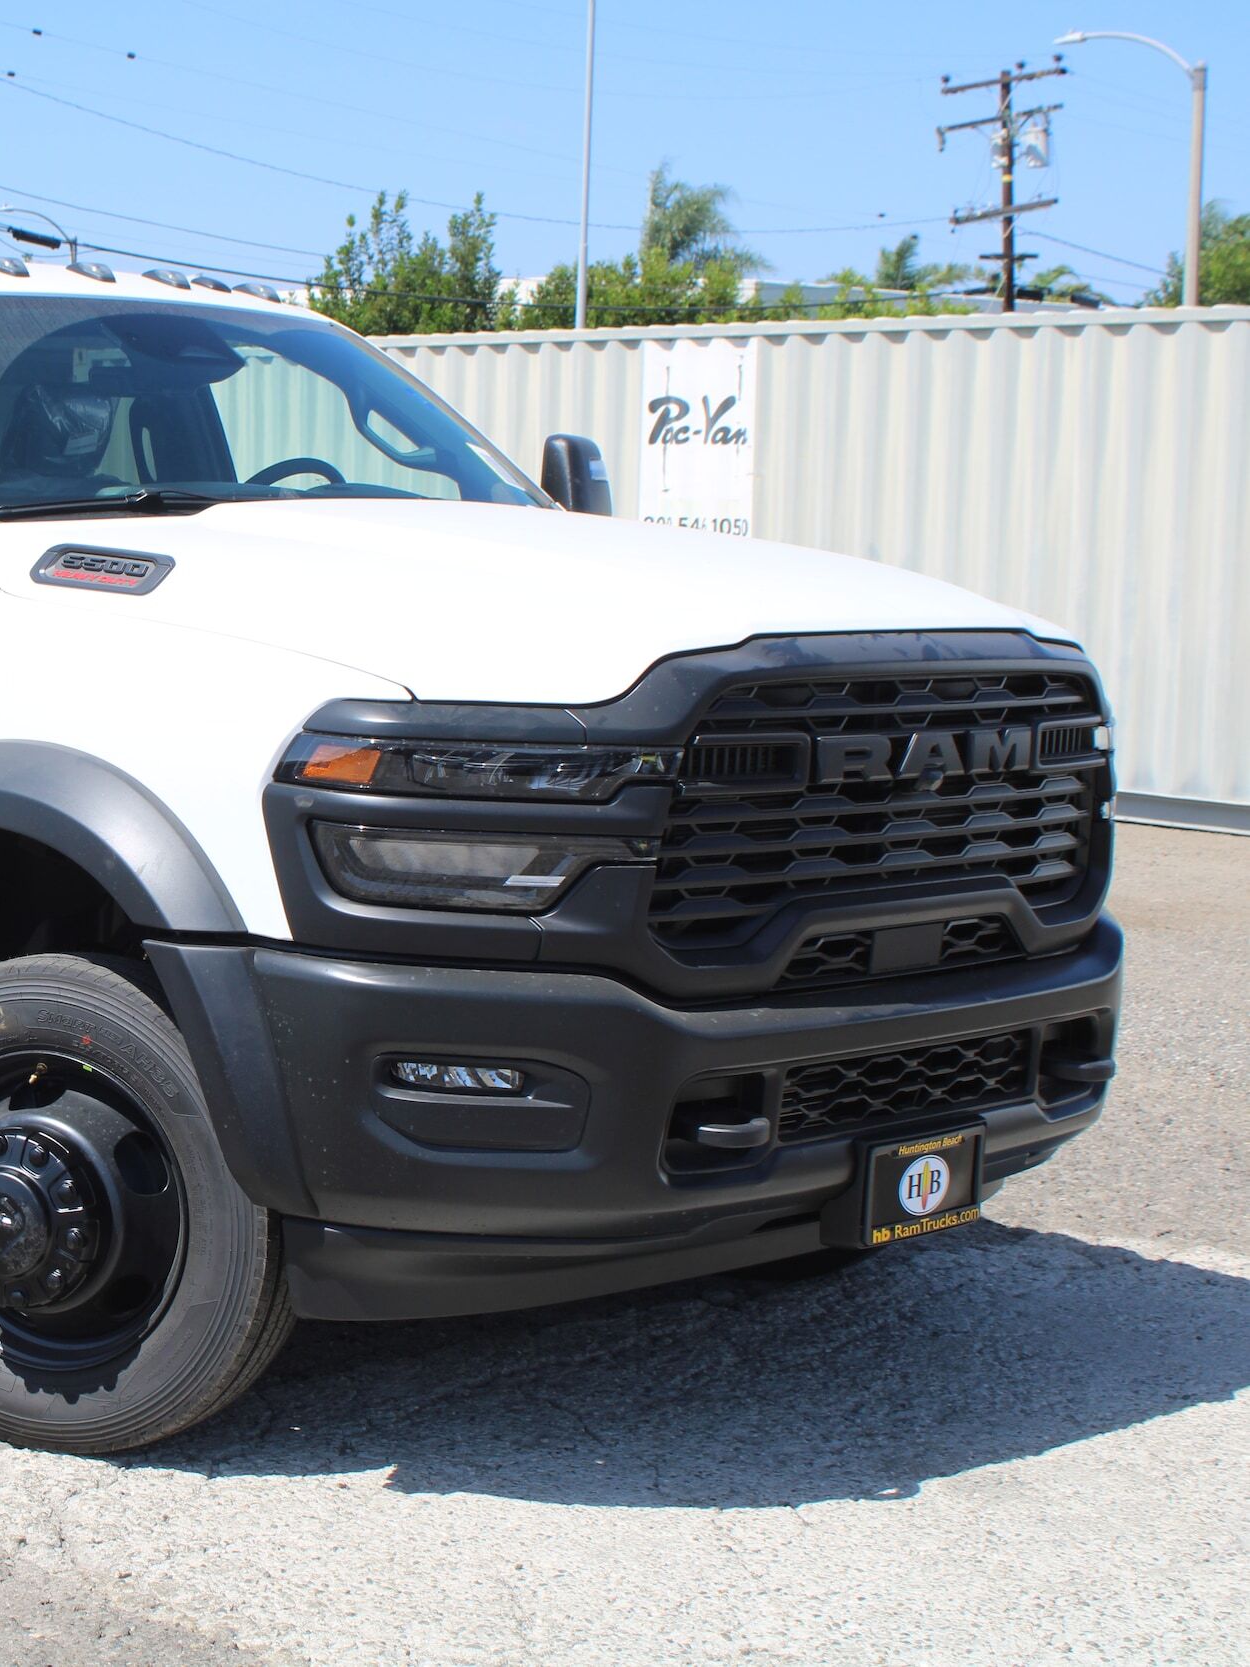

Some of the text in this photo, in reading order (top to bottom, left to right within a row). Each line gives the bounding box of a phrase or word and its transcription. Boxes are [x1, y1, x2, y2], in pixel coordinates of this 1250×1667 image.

[61, 554, 150, 578] 5500
[816, 726, 1033, 784] RAM
[899, 1134, 963, 1155] Huntington Beach
[872, 1227, 892, 1244] hb
